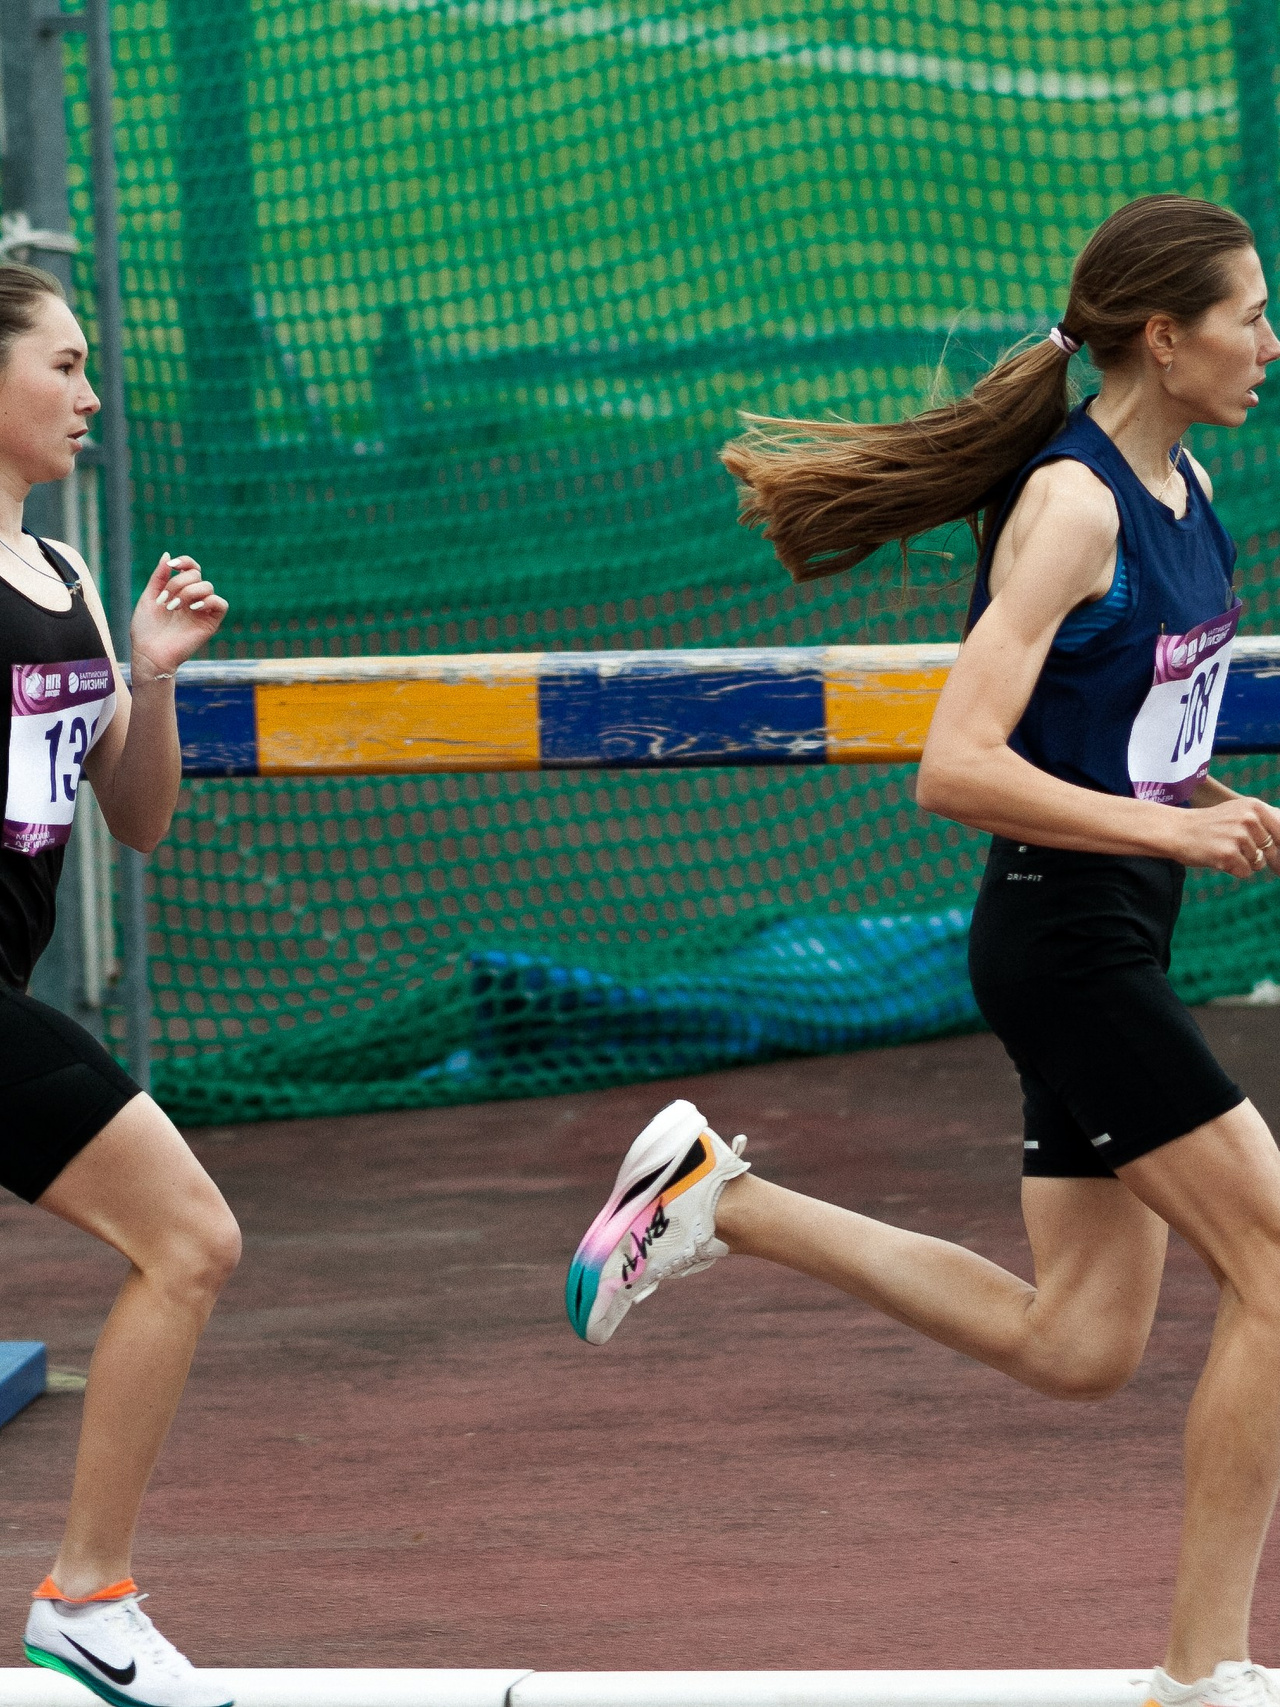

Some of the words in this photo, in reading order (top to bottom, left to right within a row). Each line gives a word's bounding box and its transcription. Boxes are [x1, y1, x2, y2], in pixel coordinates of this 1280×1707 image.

[79, 670, 109, 680] БАЛТИЙСКИЙ
[79, 678, 109, 691] ЛИЗИНГ
[45, 716, 100, 803] 13
[1006, 873, 1043, 882] DRI-FIT
